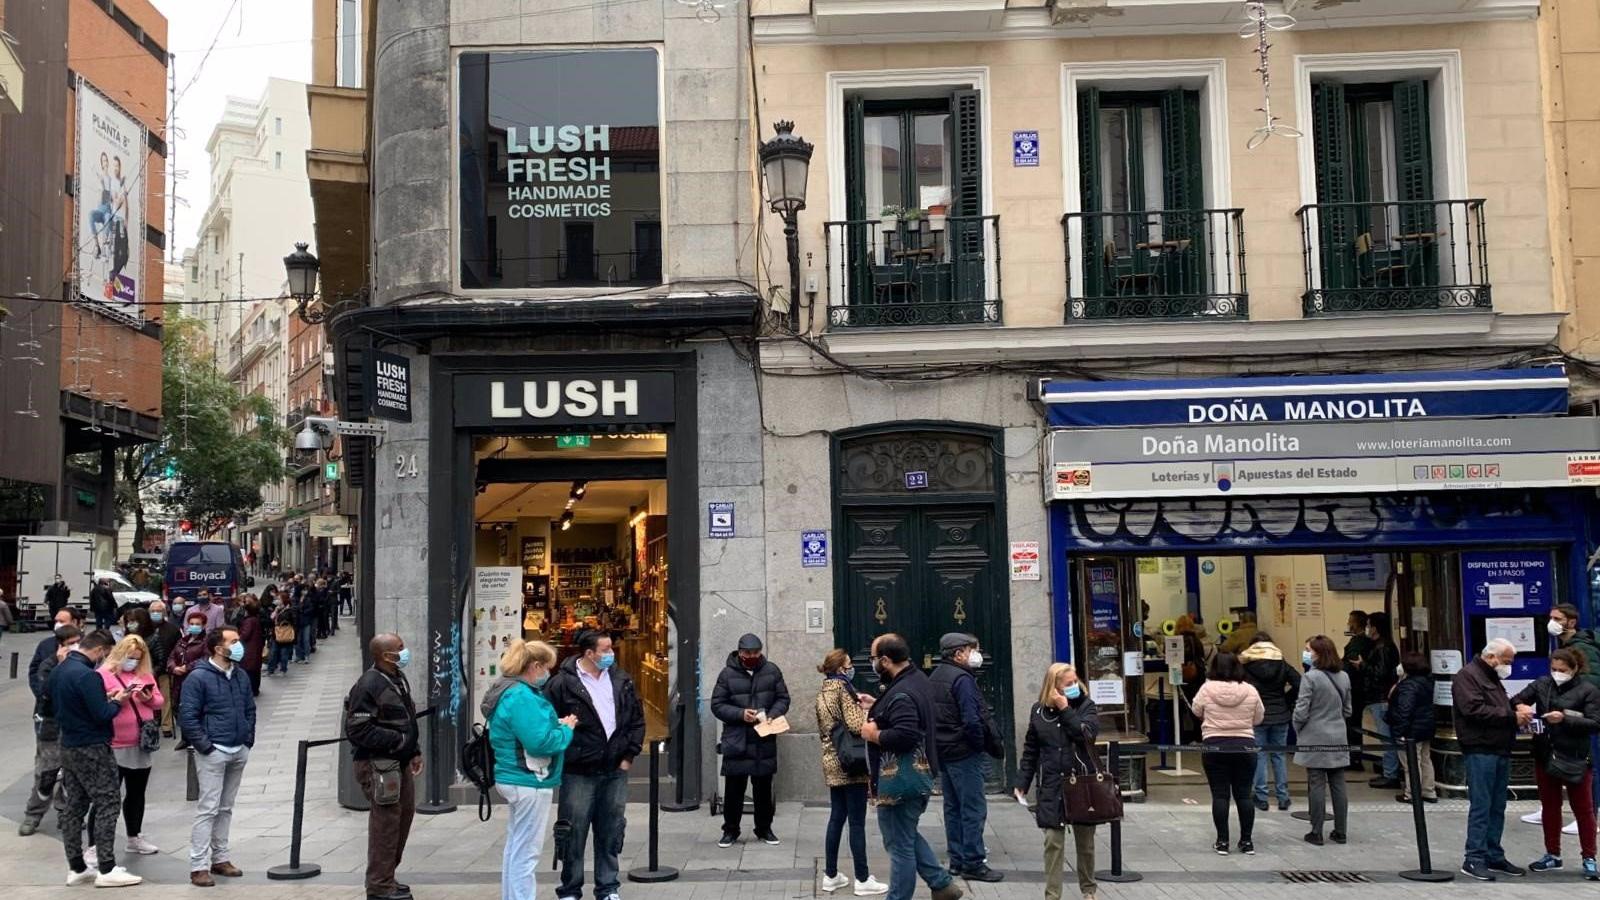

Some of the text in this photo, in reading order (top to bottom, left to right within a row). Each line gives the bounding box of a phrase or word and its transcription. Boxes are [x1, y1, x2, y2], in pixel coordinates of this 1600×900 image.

[92, 113, 121, 142] PLANTA
[507, 124, 610, 153] LUSH
[507, 157, 611, 183] FRESH
[508, 184, 611, 200] HANDMADE
[508, 202, 611, 218] COSMETICS
[377, 360, 406, 381] LUSH
[377, 376, 407, 394] FRESH
[378, 389, 407, 402] HANDMADE
[490, 379, 639, 418] LUSH
[378, 398, 407, 411] COSMETICS
[1188, 398, 1427, 423] DOÑA MANOLITA
[1142, 432, 1300, 456] Doña Manolita
[1356, 436, 1512, 451] www.loteriamanolita.com
[396, 453, 418, 479] 24
[909, 474, 923, 485] 22
[1151, 467, 1358, 484] Loterías y Apuestas del Estado
[1467, 561, 1499, 569] DISFRUTE
[1520, 560, 1545, 568] TIEMPO
[1503, 569, 1526, 577] PASOS
[189, 570, 226, 581] Boyacá
